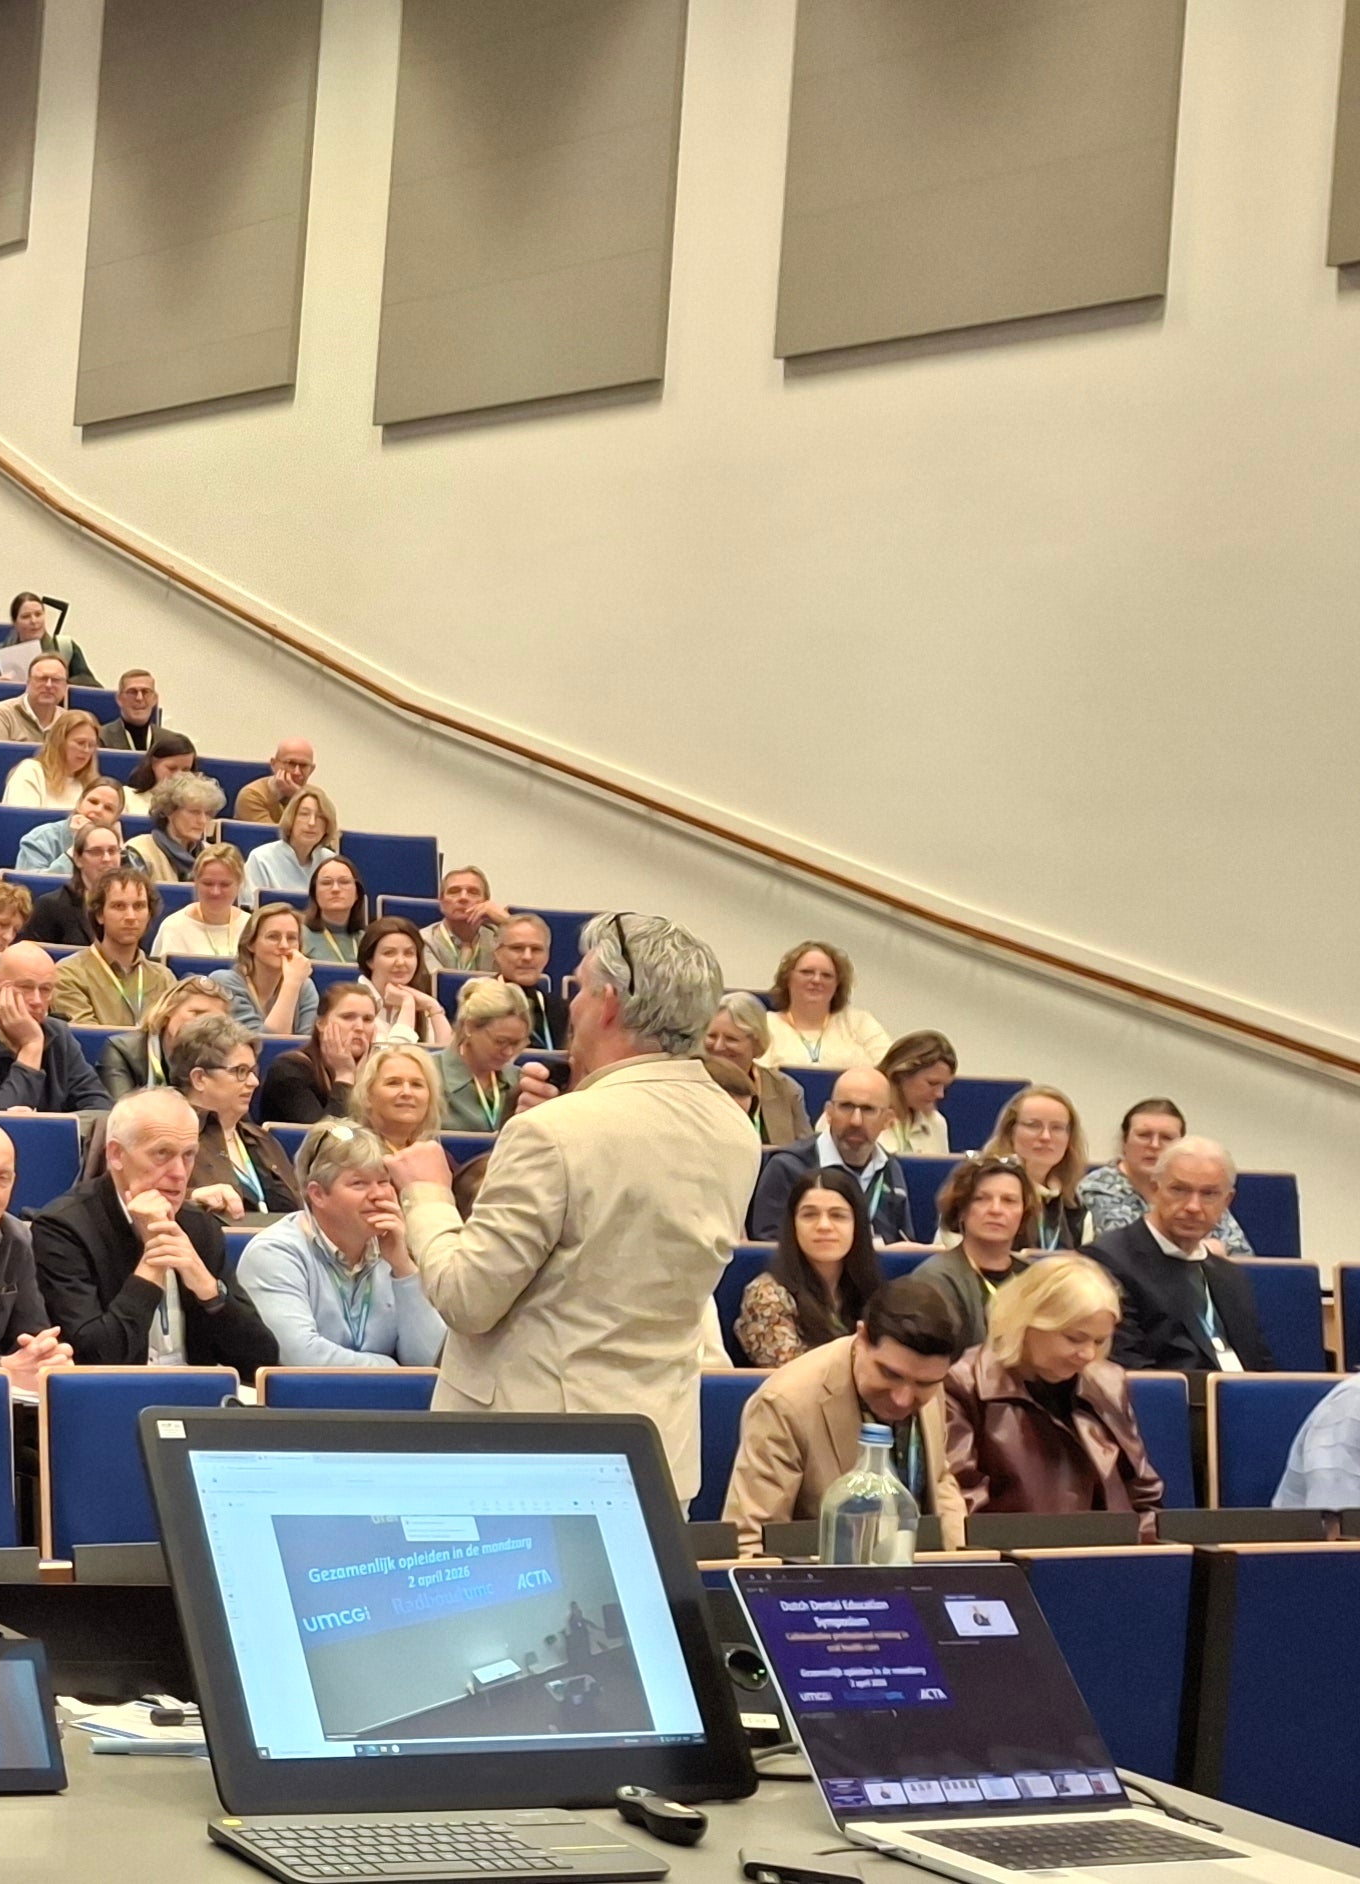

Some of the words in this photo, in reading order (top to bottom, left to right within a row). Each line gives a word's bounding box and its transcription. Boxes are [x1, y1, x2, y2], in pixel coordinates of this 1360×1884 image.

[308, 1556, 396, 1583] Gezamenlijk
[398, 1549, 450, 1570] opleiden
[452, 1545, 464, 1560] in
[466, 1543, 479, 1557] de
[407, 1575, 416, 1588] 2
[418, 1569, 443, 1587] april
[445, 1565, 471, 1580] 2026
[517, 1569, 552, 1590] ACTA
